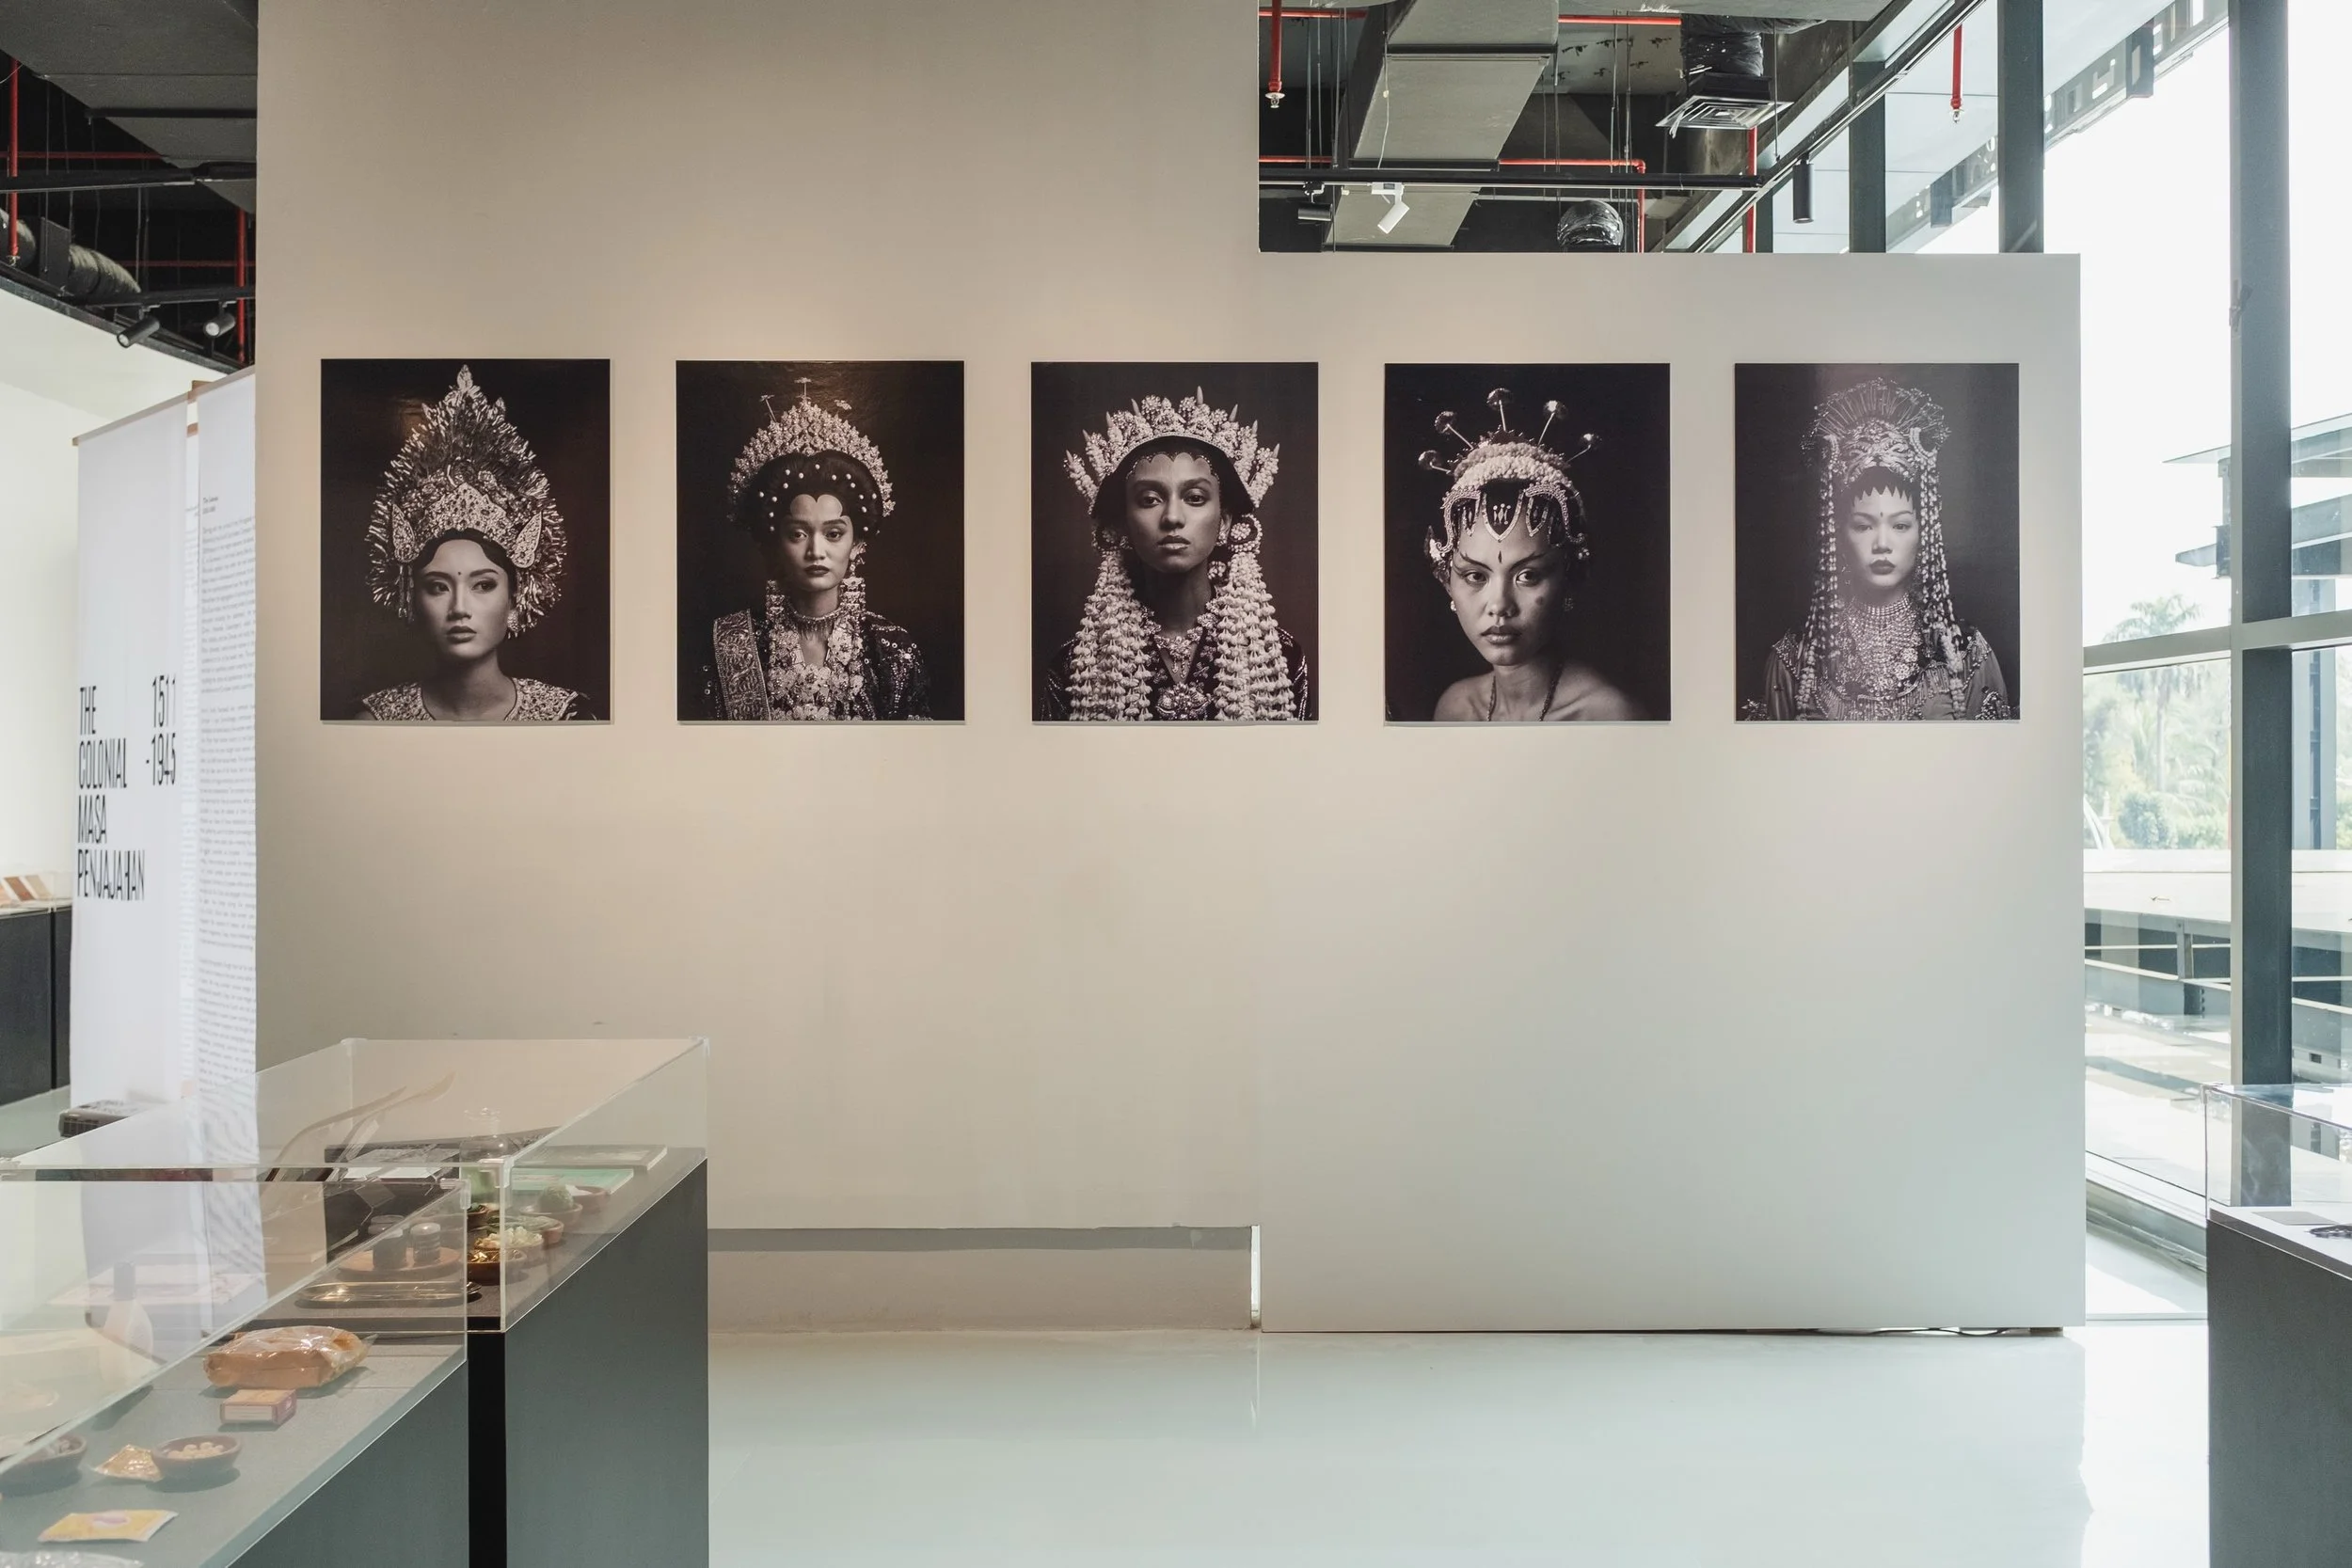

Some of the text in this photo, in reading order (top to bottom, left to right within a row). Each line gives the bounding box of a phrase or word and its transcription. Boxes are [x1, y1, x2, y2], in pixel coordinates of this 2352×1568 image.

[79, 686, 97, 736] THE
[151, 673, 176, 728] 1511
[78, 737, 127, 790] COLONIAL
[77, 794, 107, 844] MASA
[77, 848, 146, 901] PENJAJAHAN
